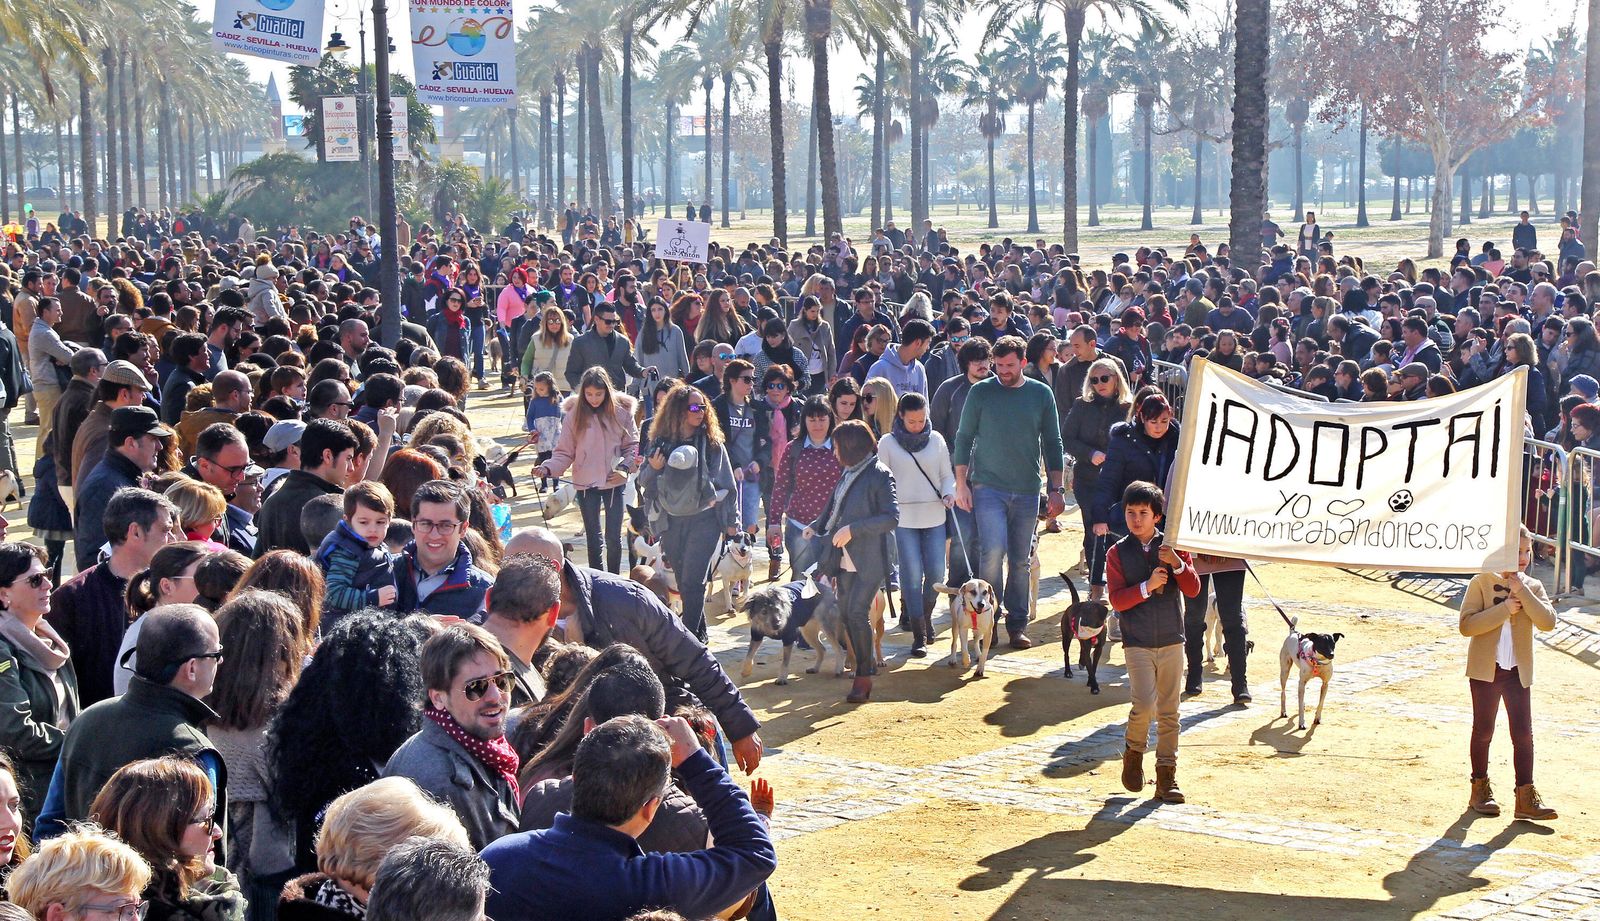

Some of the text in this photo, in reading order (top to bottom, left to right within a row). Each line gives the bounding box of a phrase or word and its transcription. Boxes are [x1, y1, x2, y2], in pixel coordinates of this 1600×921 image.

[259, 15, 302, 38] Guadiel
[224, 41, 310, 60] www.bricopinturas.com
[246, 36, 280, 48] SEVILLA
[286, 43, 318, 53] HUELVA
[455, 62, 497, 81] Guadiel
[428, 94, 508, 103] www.bricopinturas.com
[446, 86, 478, 94] SEVILLA
